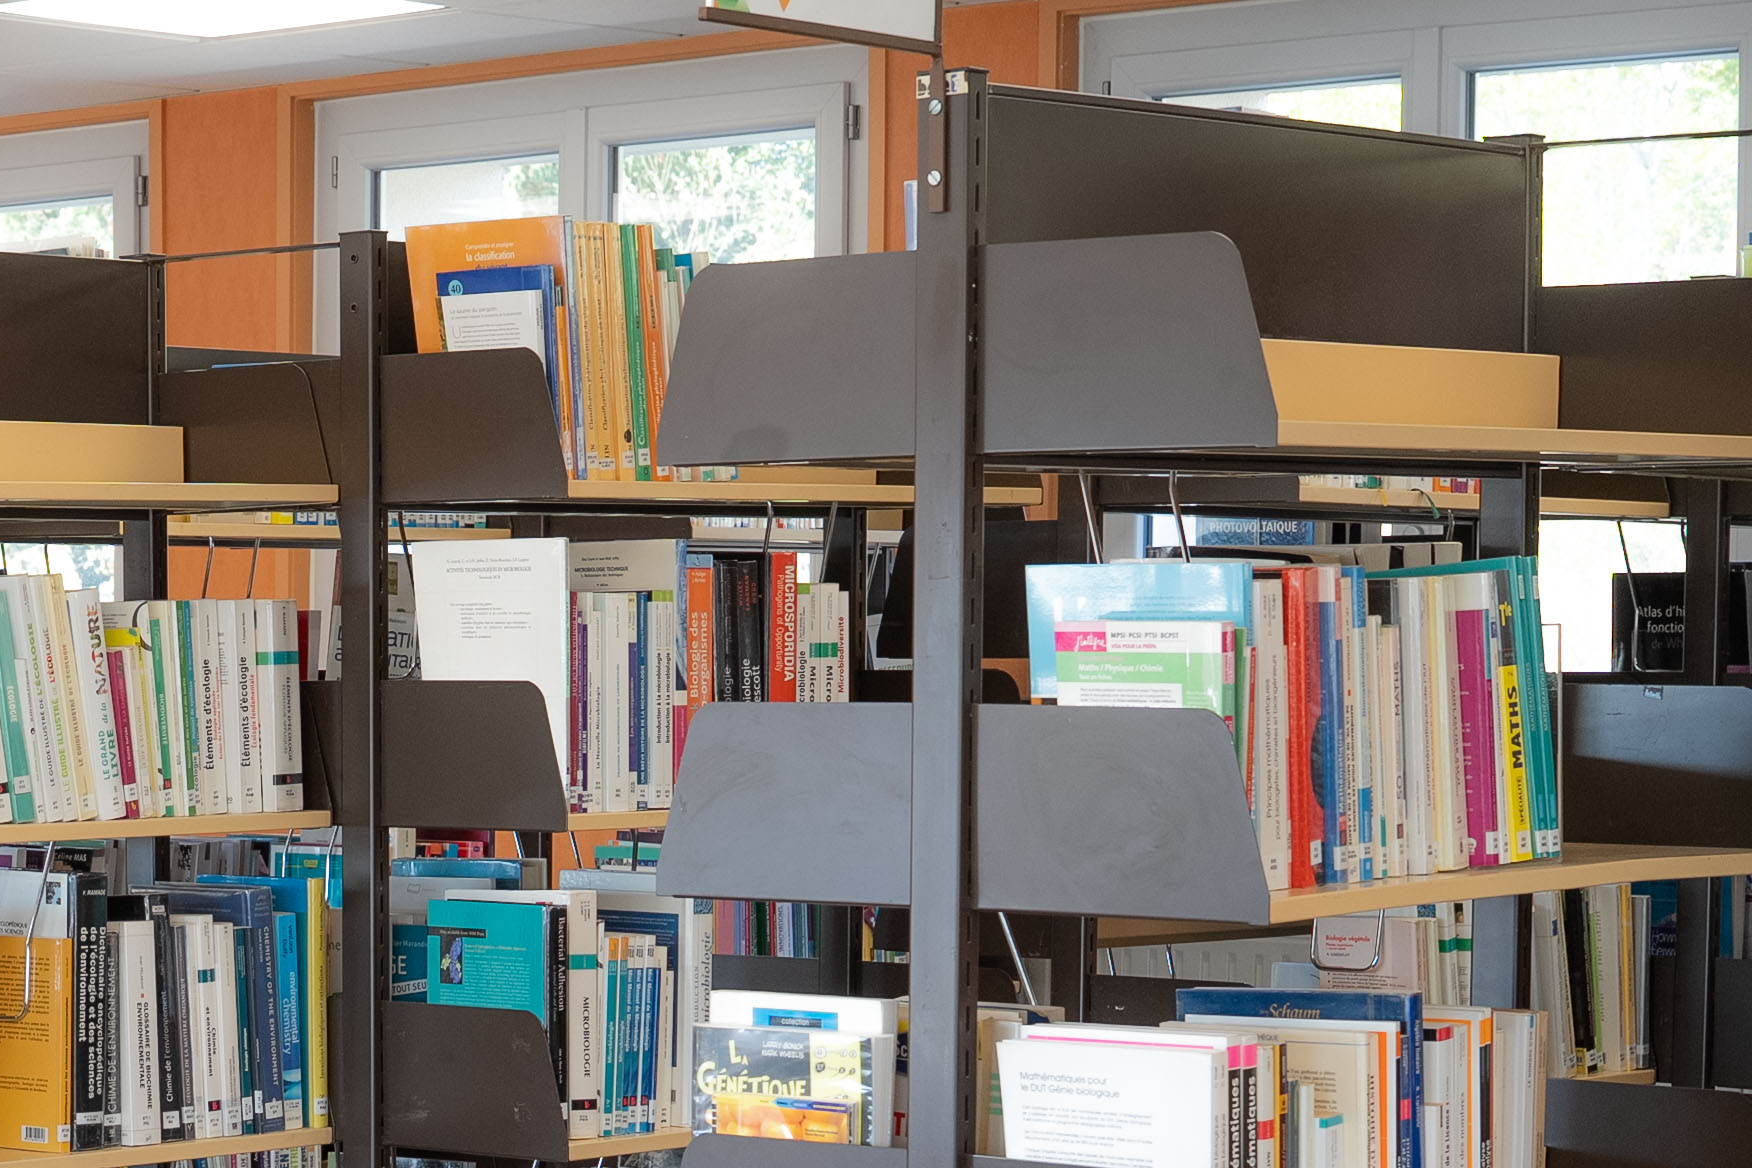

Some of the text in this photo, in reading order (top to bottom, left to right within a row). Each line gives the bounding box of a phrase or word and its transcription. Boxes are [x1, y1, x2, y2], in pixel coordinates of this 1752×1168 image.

[466, 249, 515, 260] la classification
[449, 282, 462, 295] 40
[775, 575, 784, 616] Pathogens
[784, 565, 794, 681] MICROSPORIDIA
[86, 601, 108, 695] NATURE
[690, 611, 698, 697] Biologie des
[774, 629, 784, 672] Opportunity
[37, 693, 44, 703] DE
[100, 701, 108, 721] de la
[203, 658, 214, 770] Éléments d'écologie
[239, 656, 250, 768] Éléments d'écologie
[39, 707, 49, 743] ILLUSTRÉ
[1507, 685, 1523, 769] MATHS
[44, 746, 53, 773] GUIDE
[98, 729, 110, 780] LE GRAND
[107, 729, 120, 777] LIVRE
[48, 775, 55, 785] LE
[90, 926, 97, 940] de
[79, 926, 87, 1042] de l'environnement
[89, 945, 97, 1003] l'écologie
[392, 980, 427, 993] TOUT SEU
[557, 916, 566, 1010] Bacterial Adhesion
[703, 931, 713, 1022] microbiologie
[89, 1005, 96, 1018] et
[96, 926, 106, 1095] Dictionnaire encyclopédique
[143, 1001, 151, 1048] GLOSSAIRE
[263, 926, 279, 1087] CHEMISTRY OF THE ENVIRONMENT
[288, 971, 299, 1044] environmental
[1268, 1003, 1321, 1020] Schaum
[107, 957, 116, 1112] CHIMIE DE L'ENVIRONNEMENT
[136, 1001, 145, 1088] ENVIRONNEMENTALE
[145, 1051, 151, 1061] DE
[582, 996, 591, 1078] MICROBIOLOGIE
[88, 1044, 96, 1098] sciences
[697, 1060, 808, 1097] GÉNÉTIQUE
[1019, 1070, 1108, 1089] Mathématiques pour
